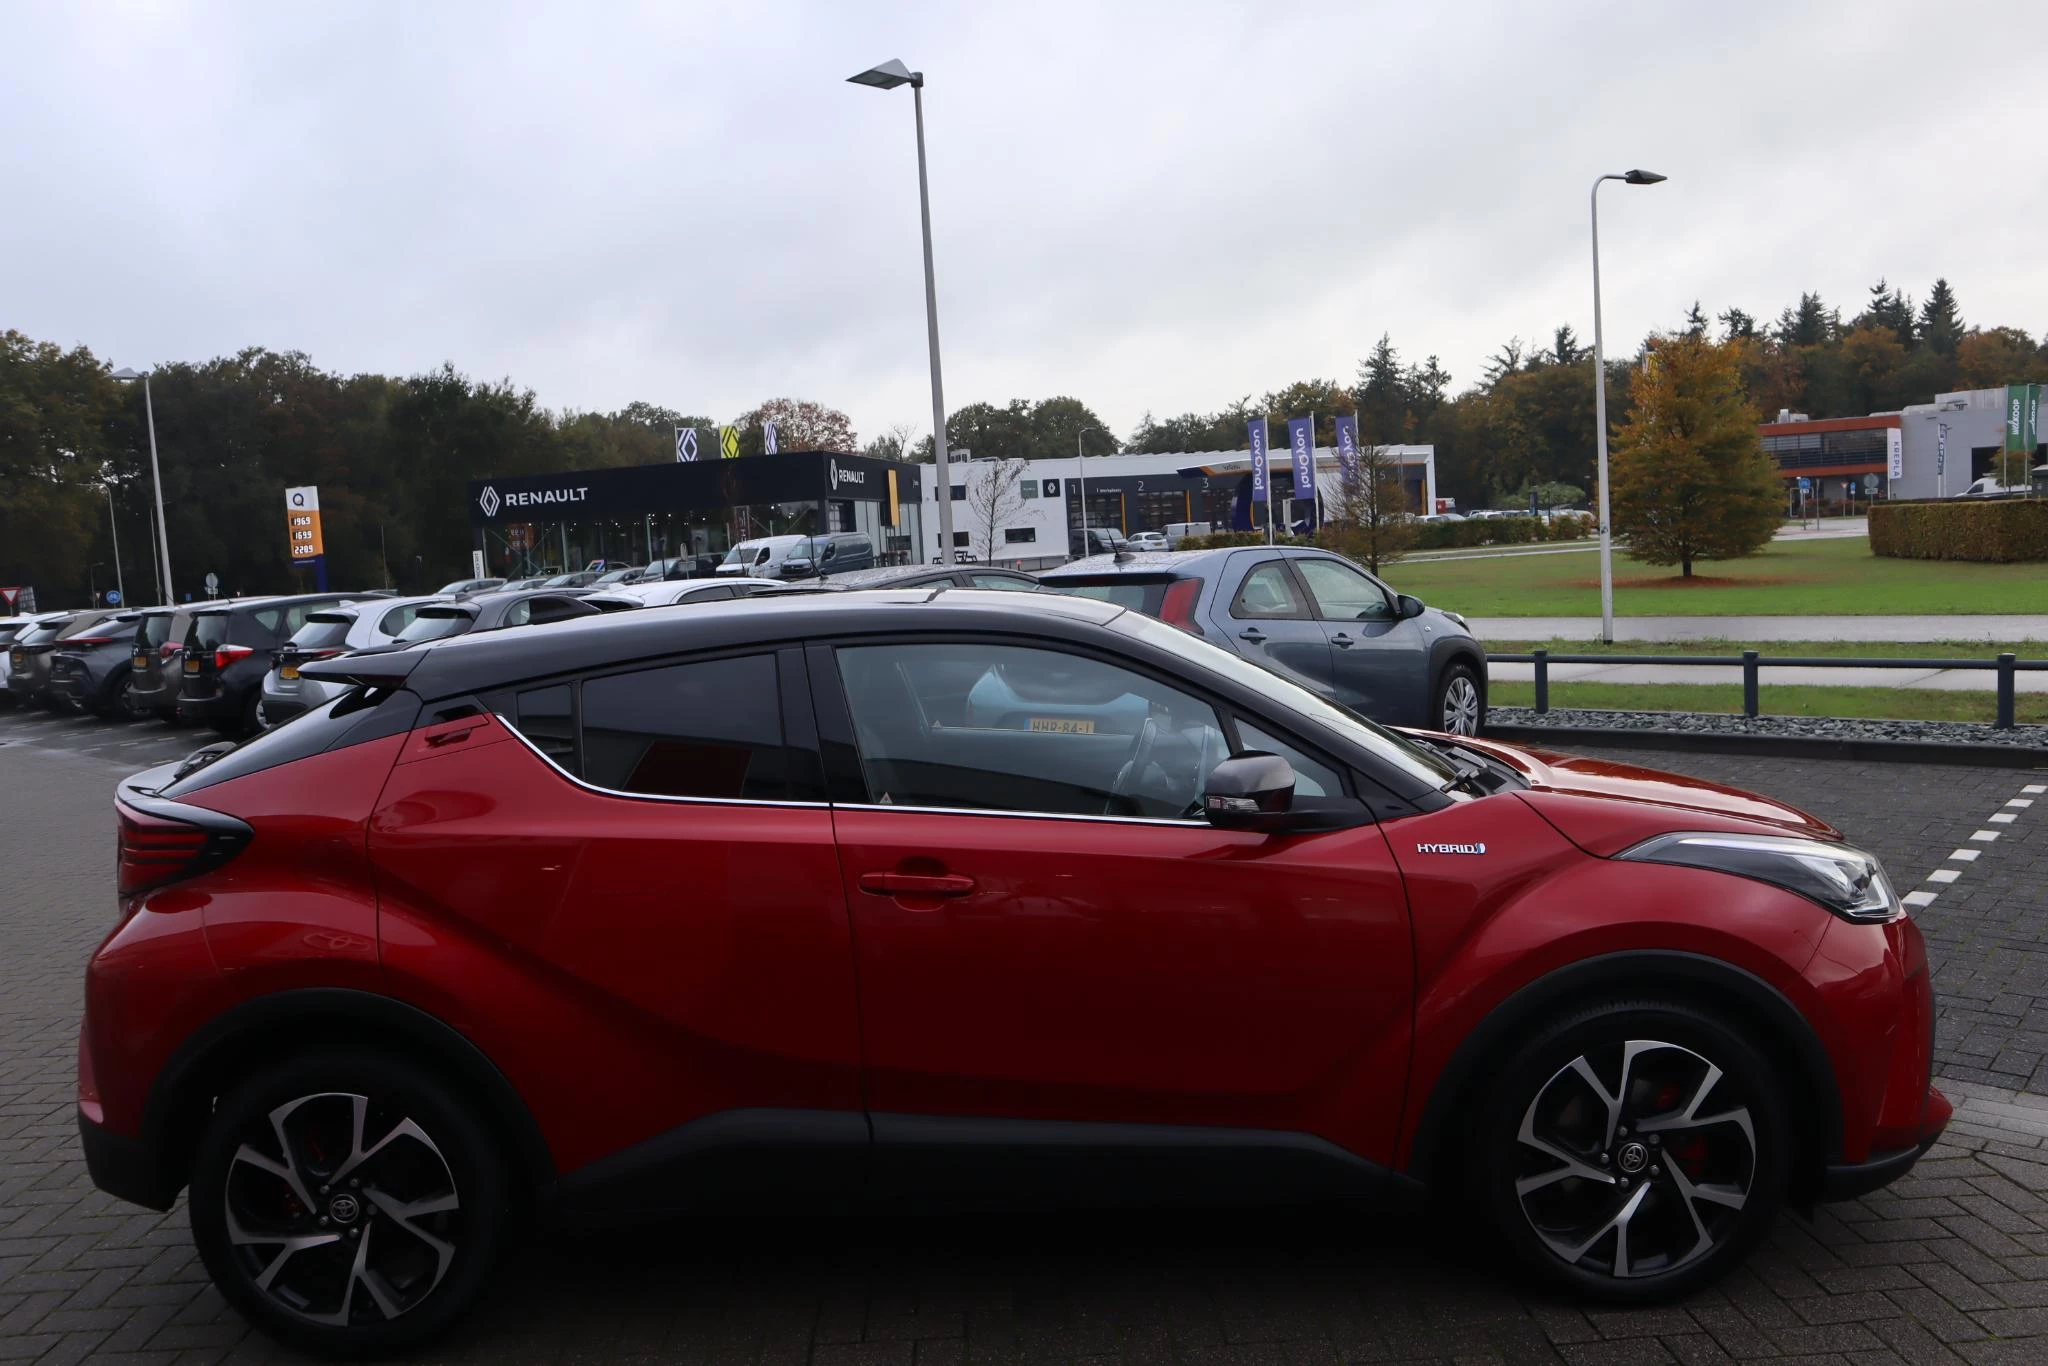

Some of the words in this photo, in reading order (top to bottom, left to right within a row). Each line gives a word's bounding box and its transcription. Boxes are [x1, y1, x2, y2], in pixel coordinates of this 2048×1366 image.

[838, 469, 865, 484] RENAULT
[1137, 480, 1145, 492] 2
[292, 492, 305, 507] Q
[504, 487, 589, 507] RENAULT
[1416, 843, 1475, 854] HYBRID
